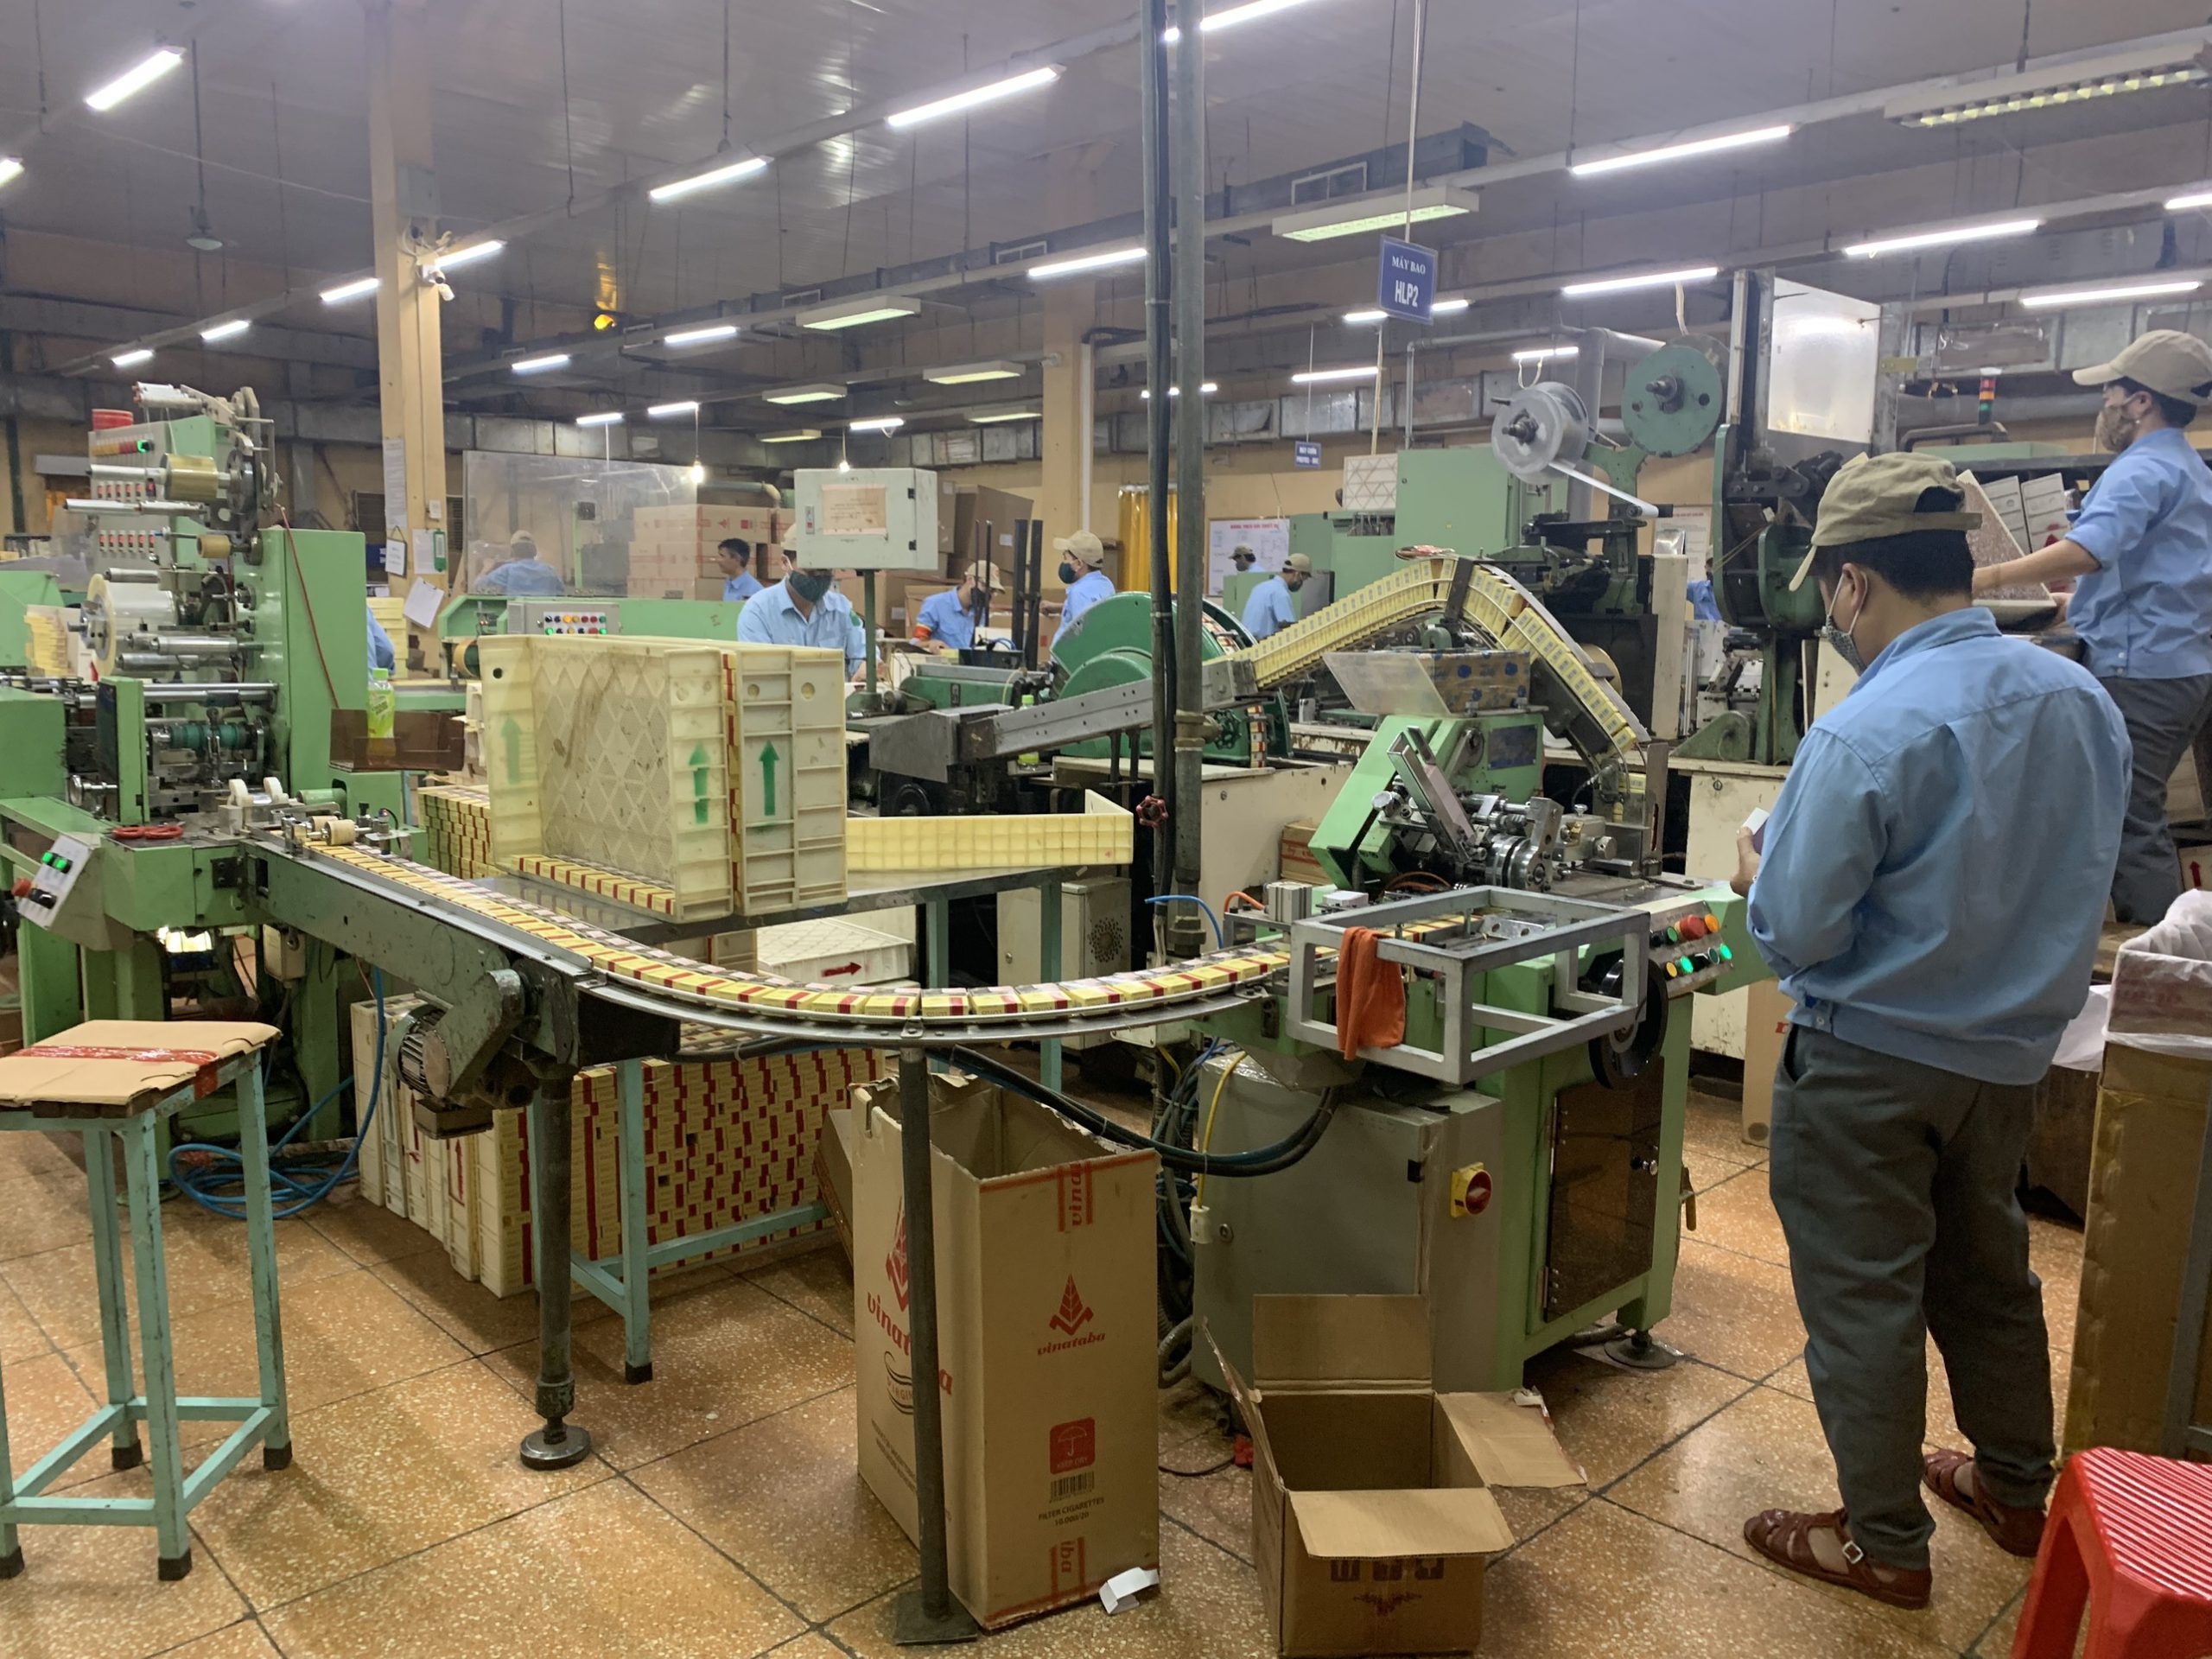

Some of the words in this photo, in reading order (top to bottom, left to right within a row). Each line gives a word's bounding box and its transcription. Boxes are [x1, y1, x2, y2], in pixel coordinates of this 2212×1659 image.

[1392, 256, 1409, 270] MÁY
[1410, 262, 1426, 275] BAO
[1395, 279, 1419, 308] HLP2
[868, 1291, 953, 1395] vinata
[1037, 1332, 1106, 1356] vinataba
[1038, 1509, 1061, 1521] FILTER
[1062, 1497, 1104, 1515] CIGARETTES
